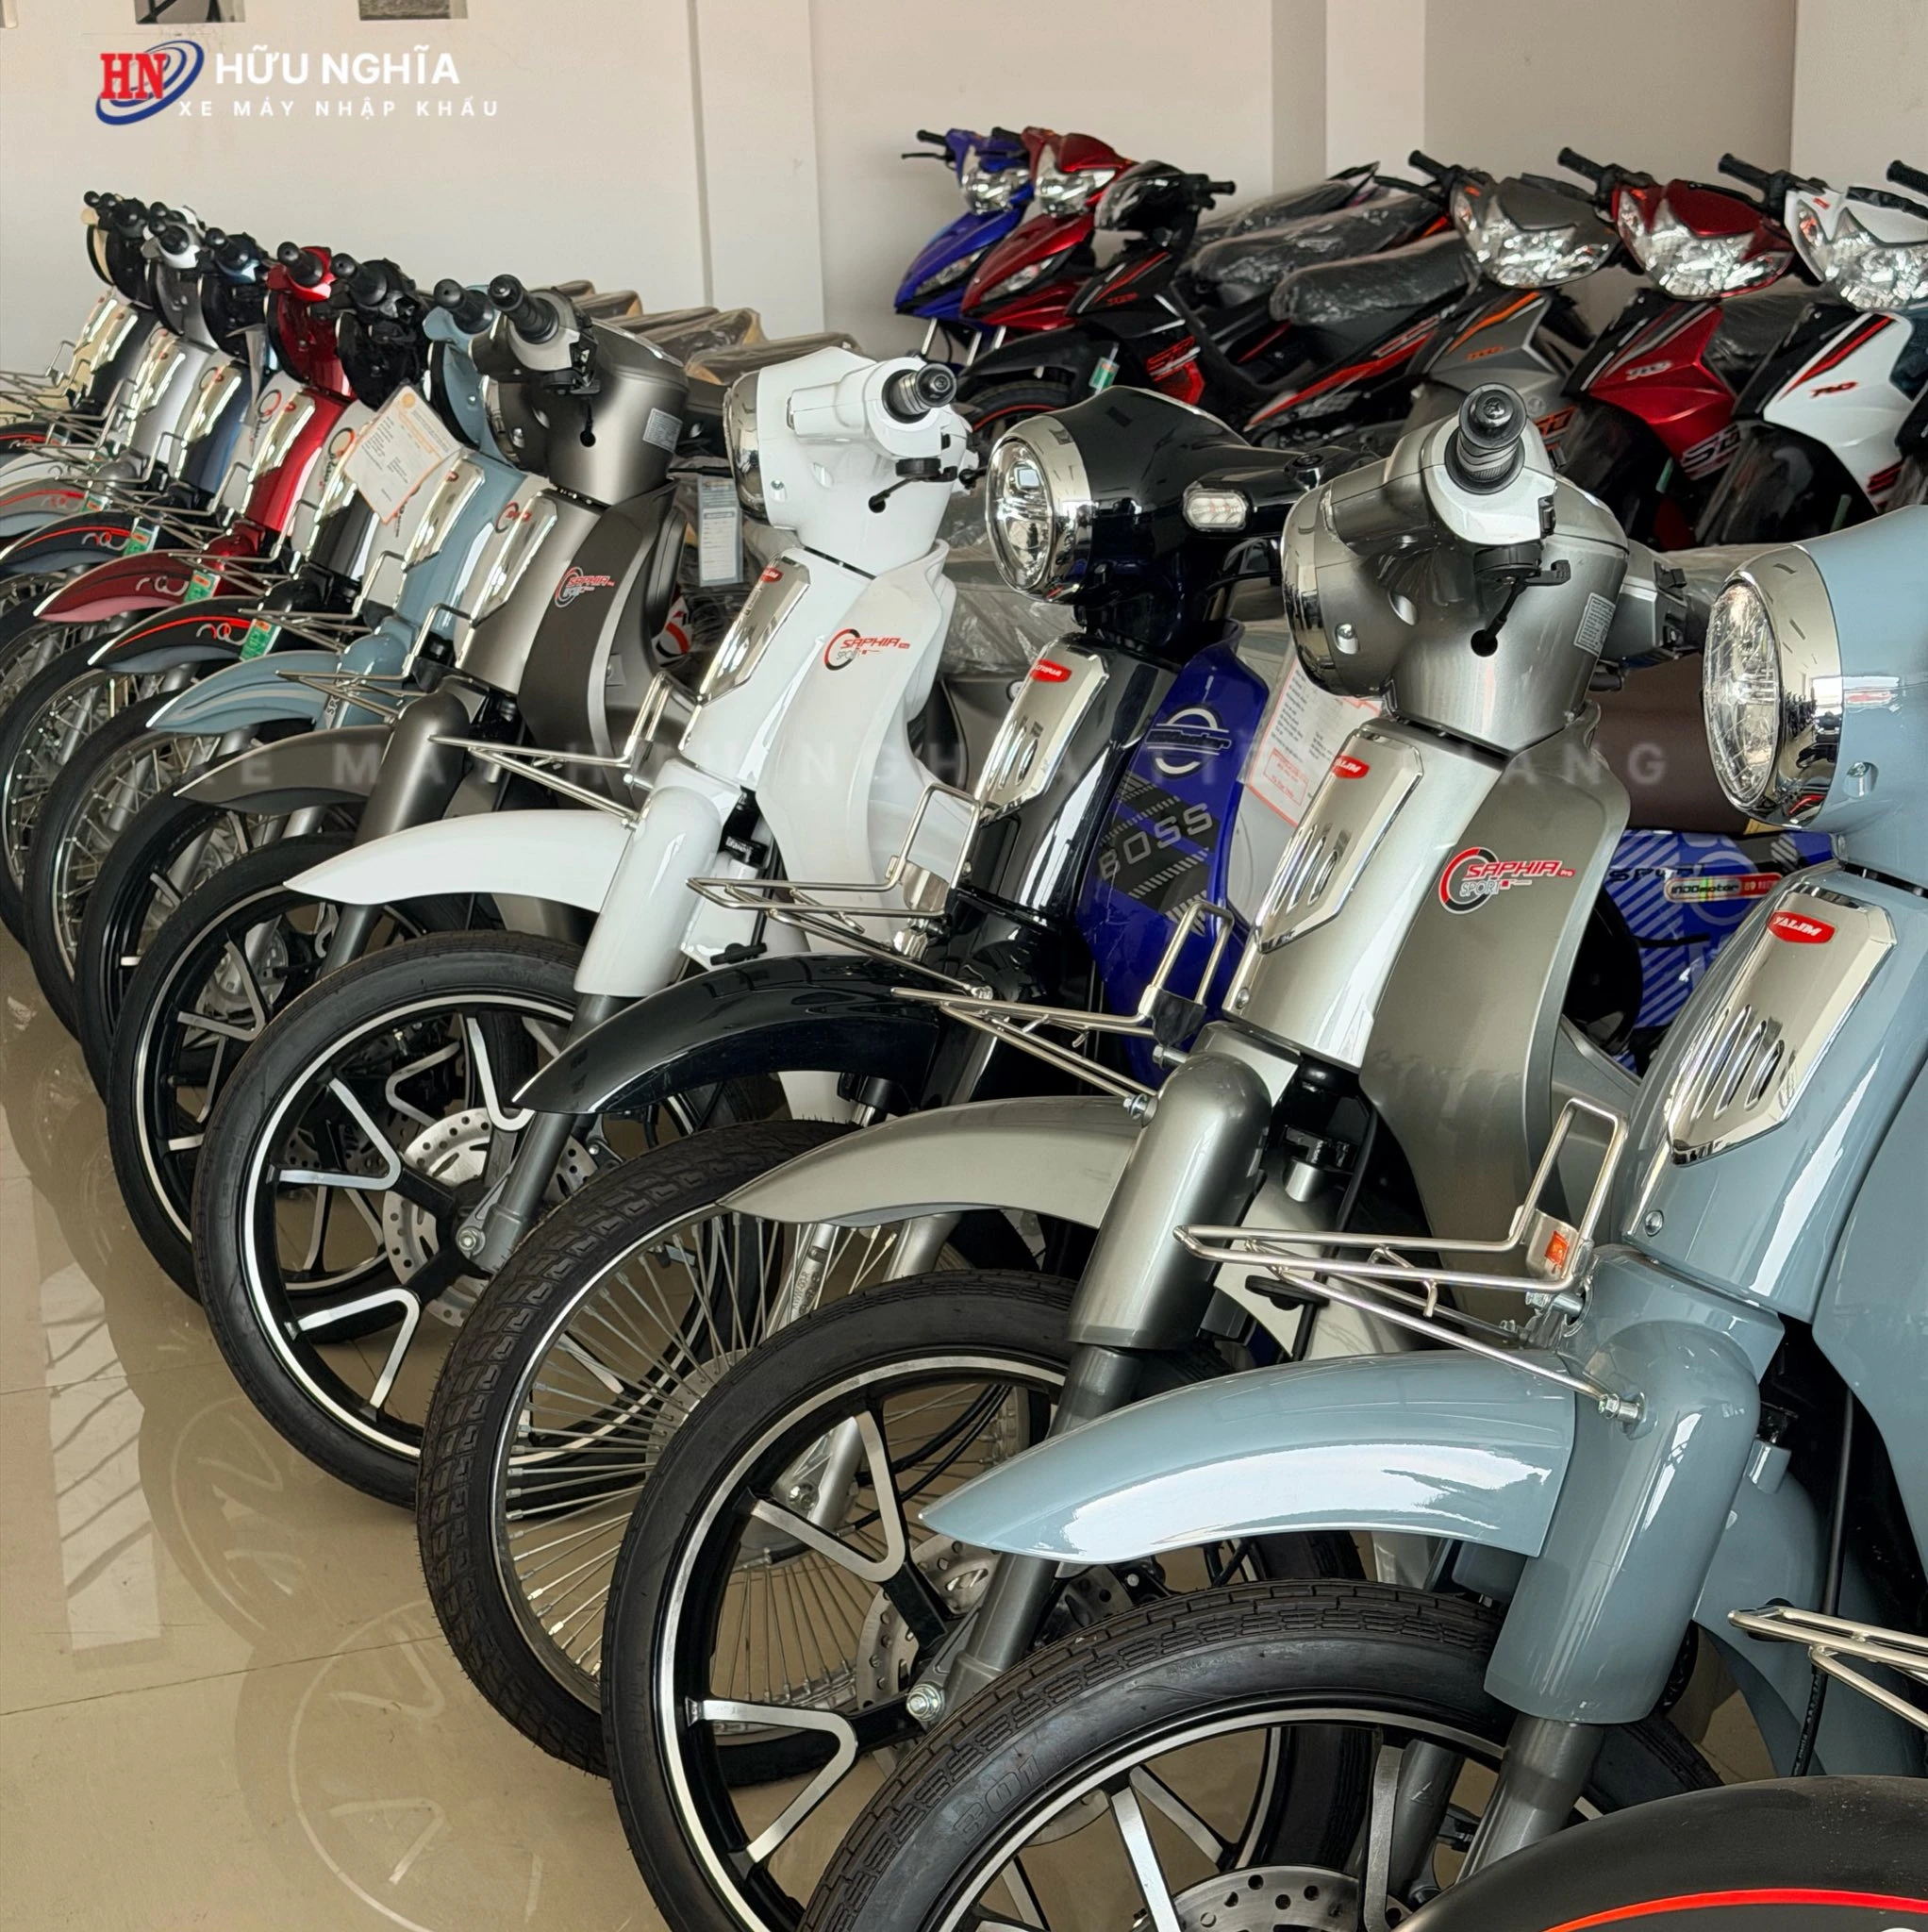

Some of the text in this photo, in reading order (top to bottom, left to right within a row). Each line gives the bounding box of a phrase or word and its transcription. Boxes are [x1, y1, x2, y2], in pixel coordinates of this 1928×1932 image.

[839, 637, 902, 650] SAPHIA
[1098, 802, 1214, 882] BOSS
[1463, 860, 1562, 881] SAPHIA
[1458, 879, 1499, 896] SPORT
